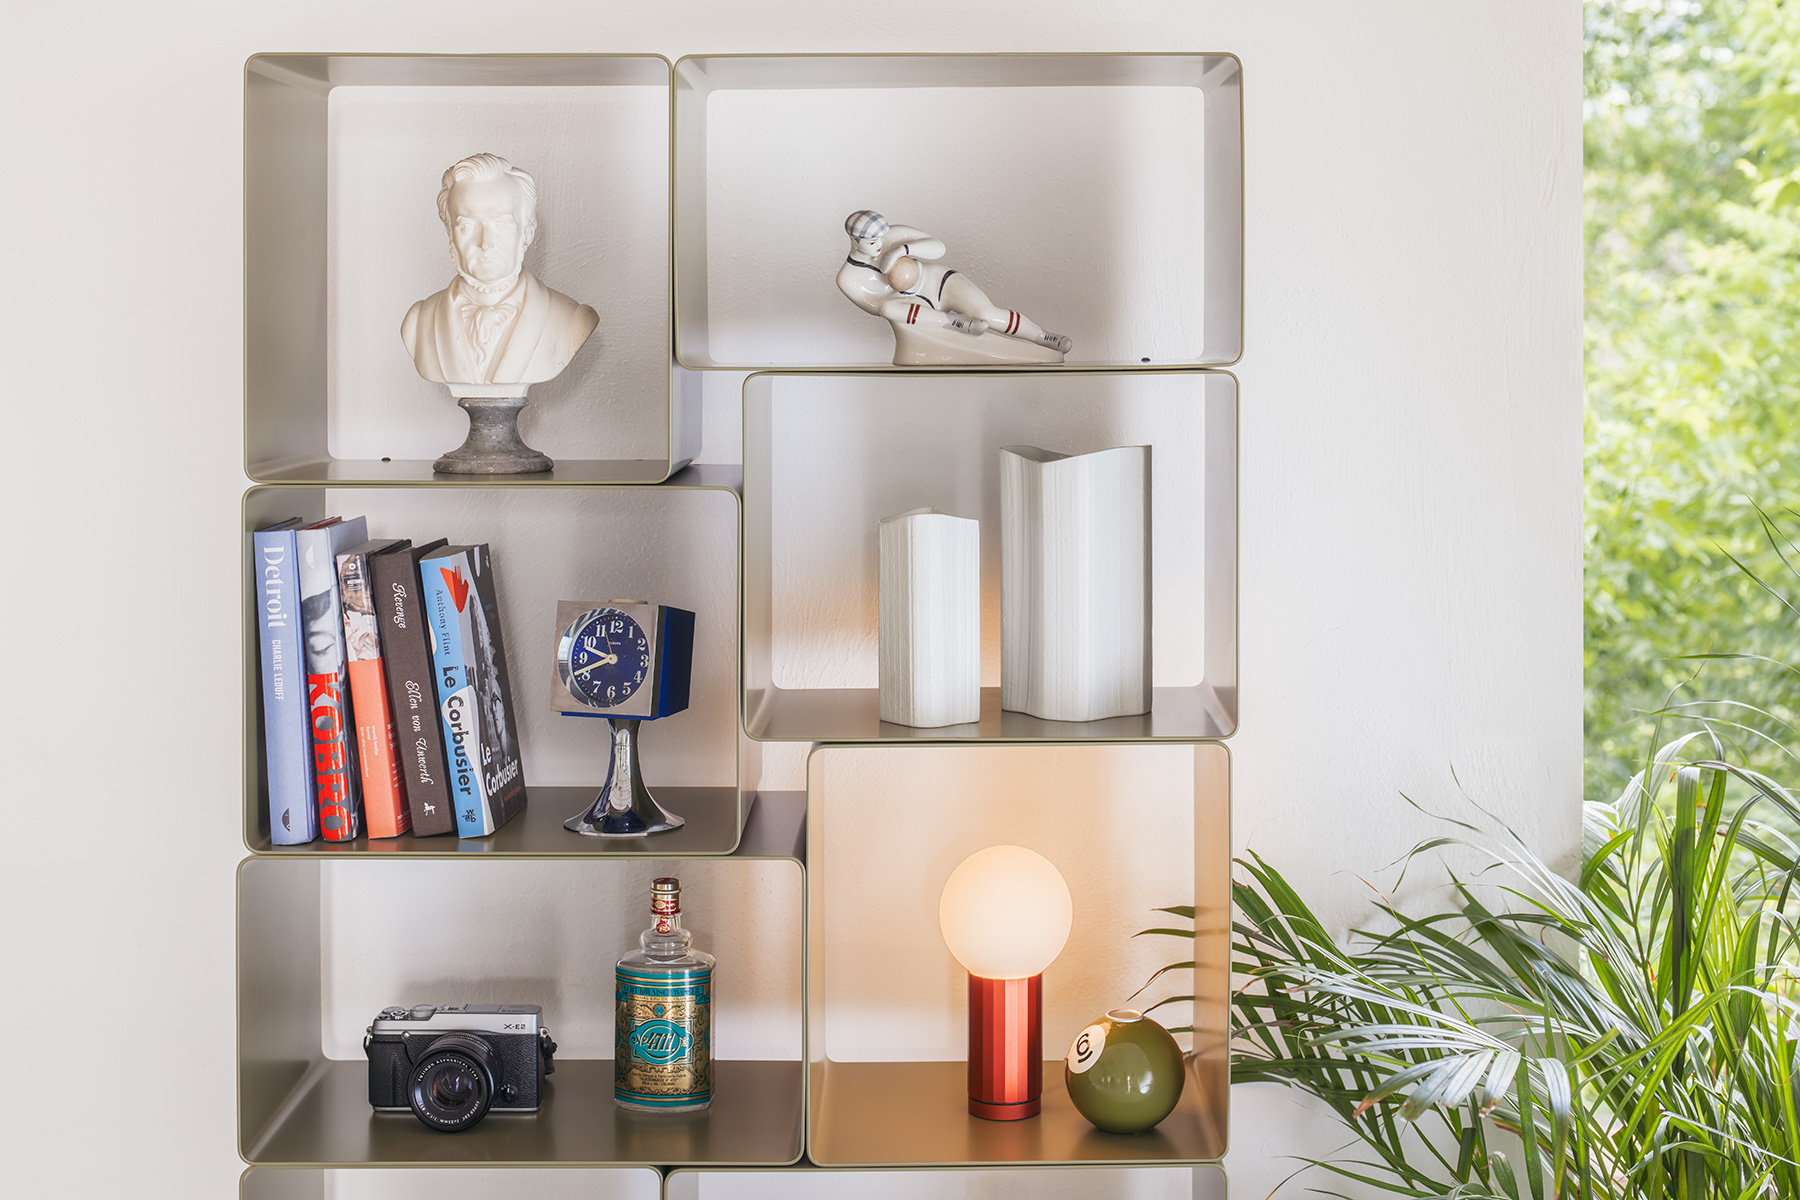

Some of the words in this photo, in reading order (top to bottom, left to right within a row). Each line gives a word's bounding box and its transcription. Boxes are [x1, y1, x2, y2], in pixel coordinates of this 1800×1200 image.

[263, 546, 288, 629] Detroit
[392, 582, 407, 629] Revenge
[436, 589, 447, 630] Anthony
[596, 624, 606, 637] 11
[609, 620, 624, 634] 12
[628, 625, 634, 639] 1
[441, 632, 451, 656] Flint
[583, 635, 597, 649] 10
[637, 637, 646, 652] 2
[271, 639, 283, 673] CHARLIE
[578, 651, 588, 665] 9
[640, 653, 649, 668] 3
[443, 665, 460, 689] Le
[581, 668, 591, 681] 8
[633, 670, 643, 684] 4
[274, 673, 285, 701] LEDUFF
[404, 680, 423, 710] Ellen
[592, 680, 602, 694] 7
[606, 685, 616, 699] 6
[622, 682, 632, 695] 5
[411, 714, 421, 733] von
[308, 672, 351, 841] KOBRO
[447, 695, 474, 796] Corbusier
[480, 742, 492, 766] Le
[415, 737, 434, 785] Unwerth
[485, 755, 519, 797] Corbusier
[1076, 1033, 1090, 1057] 6
